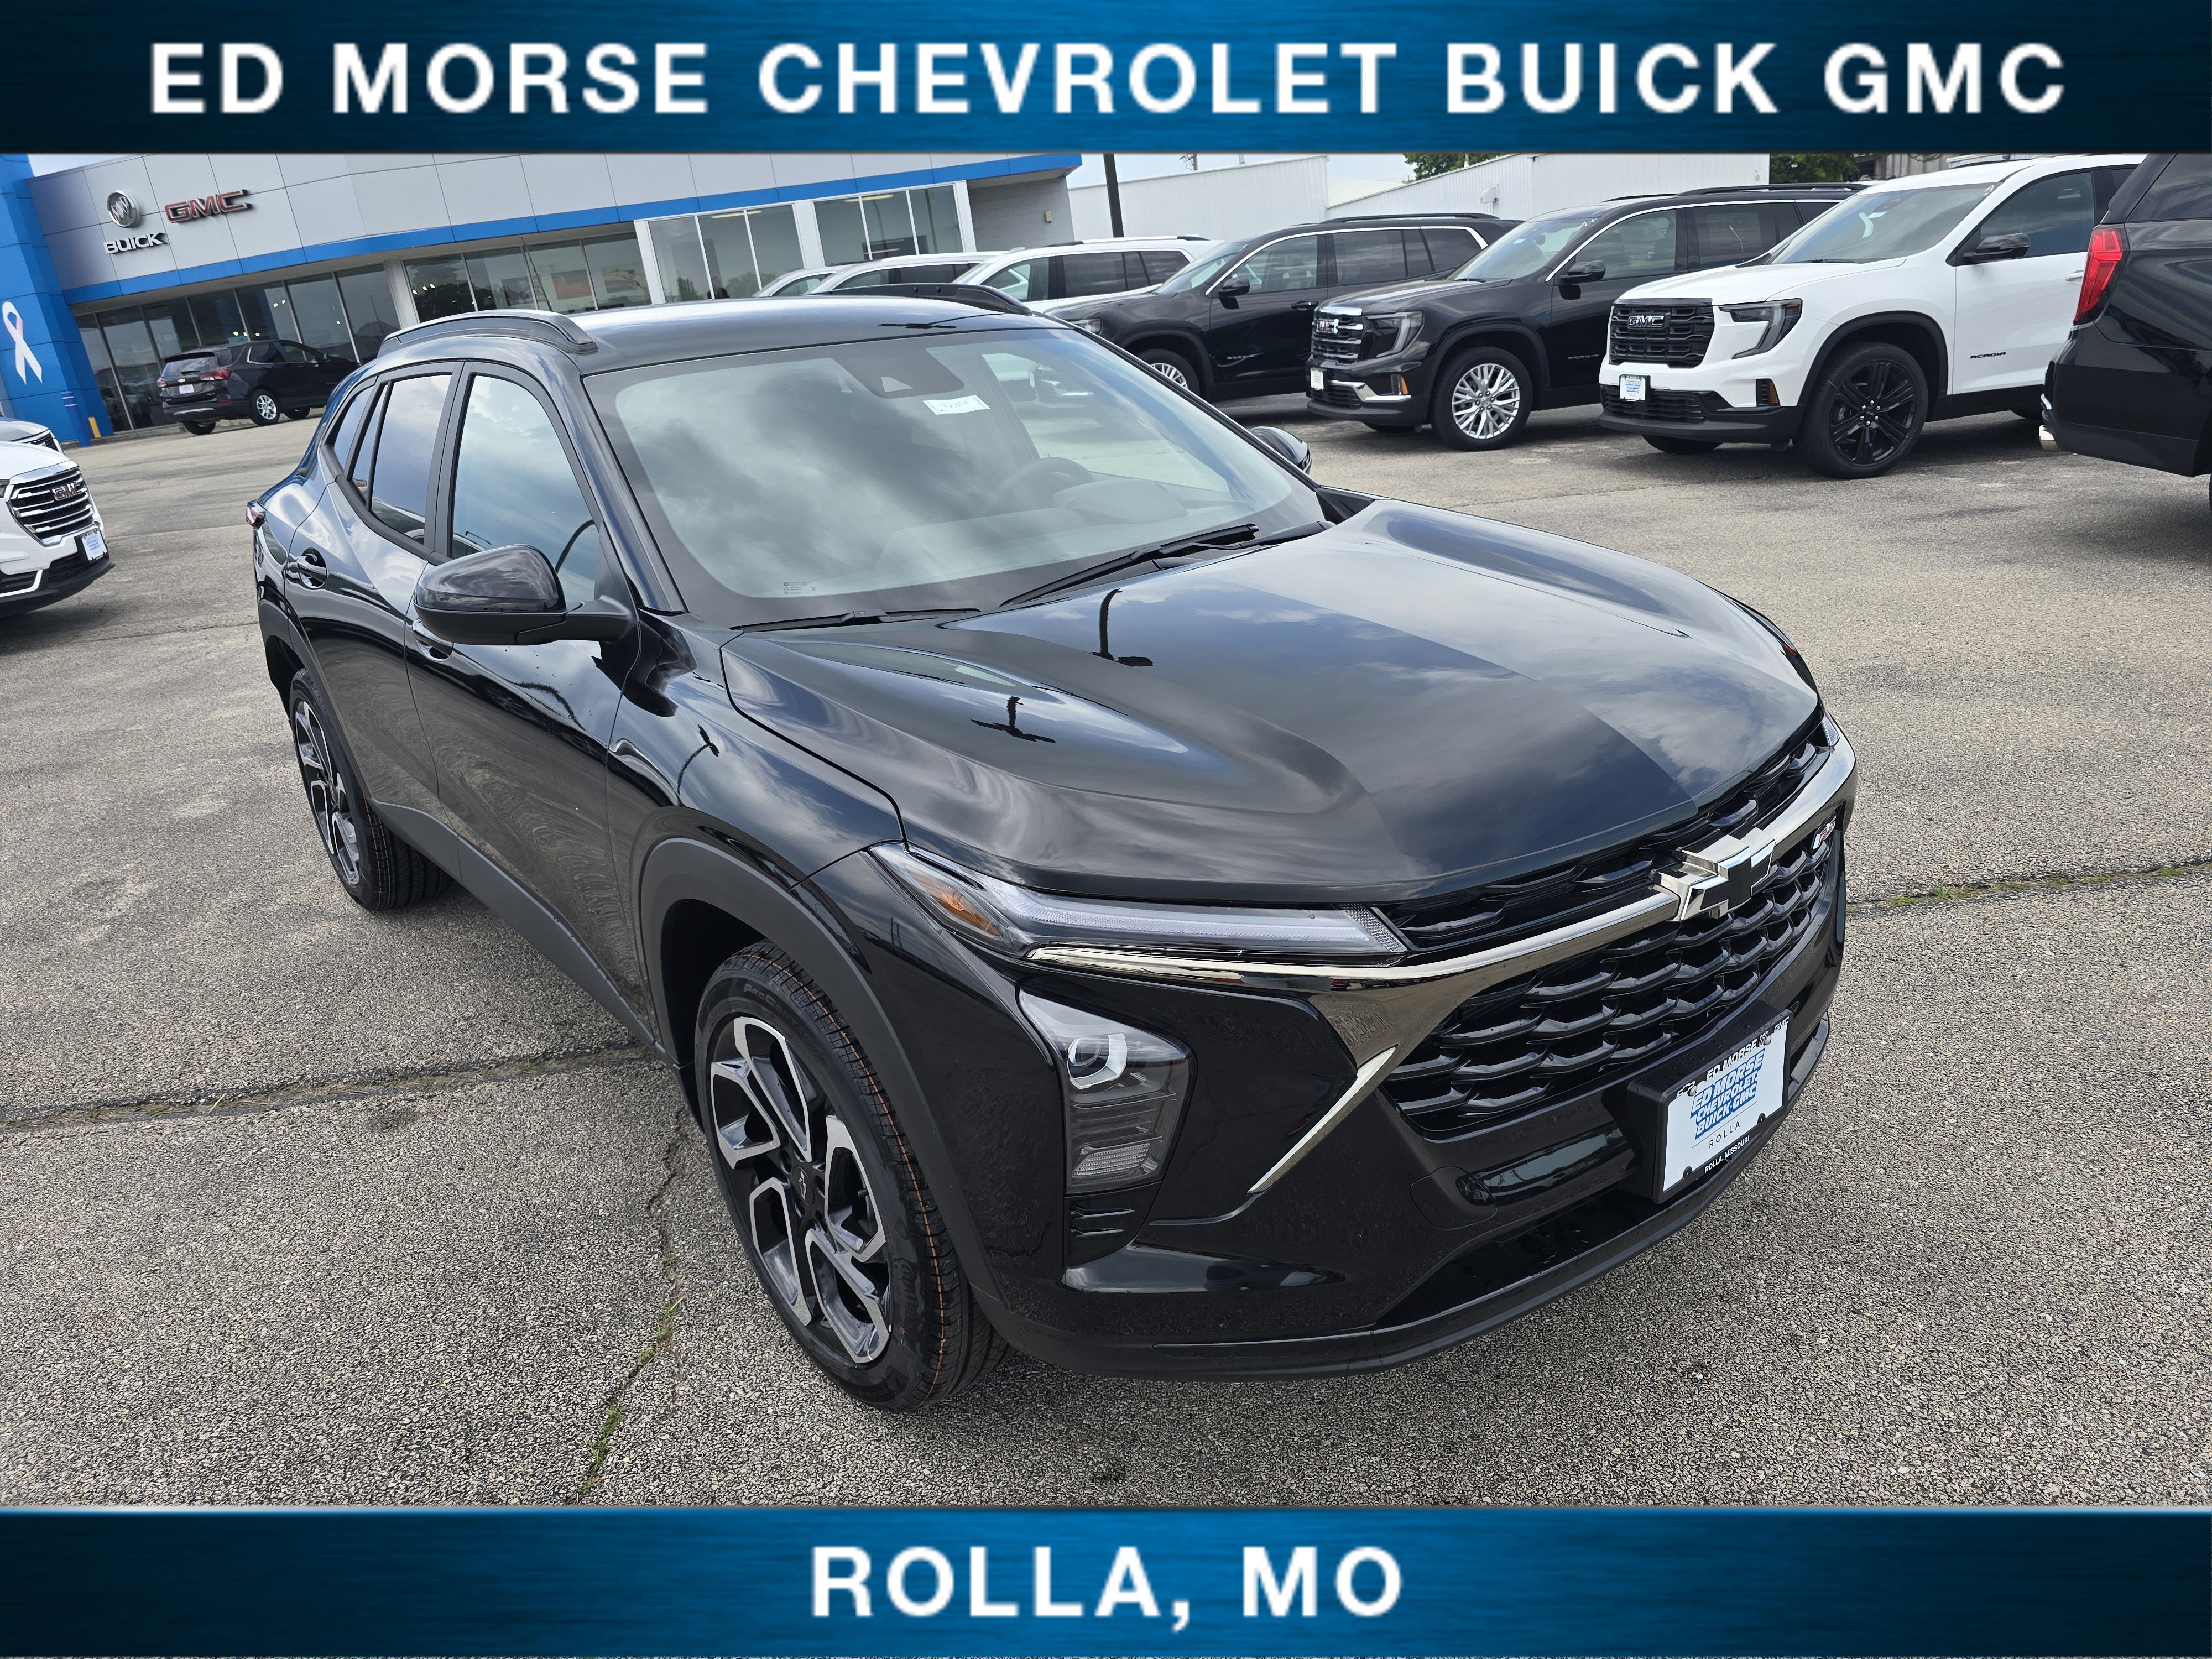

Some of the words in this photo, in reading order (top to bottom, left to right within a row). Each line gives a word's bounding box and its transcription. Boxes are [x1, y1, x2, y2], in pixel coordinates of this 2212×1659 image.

[165, 189, 248, 223] GMC
[103, 232, 163, 254] BUICK
[1627, 315, 1665, 328] GMC
[52, 482, 84, 501] GMC
[1707, 1063, 1720, 1079] ED
[1722, 1038, 1759, 1070] MORSE
[1691, 1086, 1713, 1114] ED
[1713, 1050, 1765, 1098] MORSE
[1696, 1070, 1758, 1123] CHEVROLET
[1709, 1120, 1740, 1149] ROLLA
[1704, 1156, 1724, 1173] ROLLA,
[1724, 1135, 1750, 1159] MISSOURI
